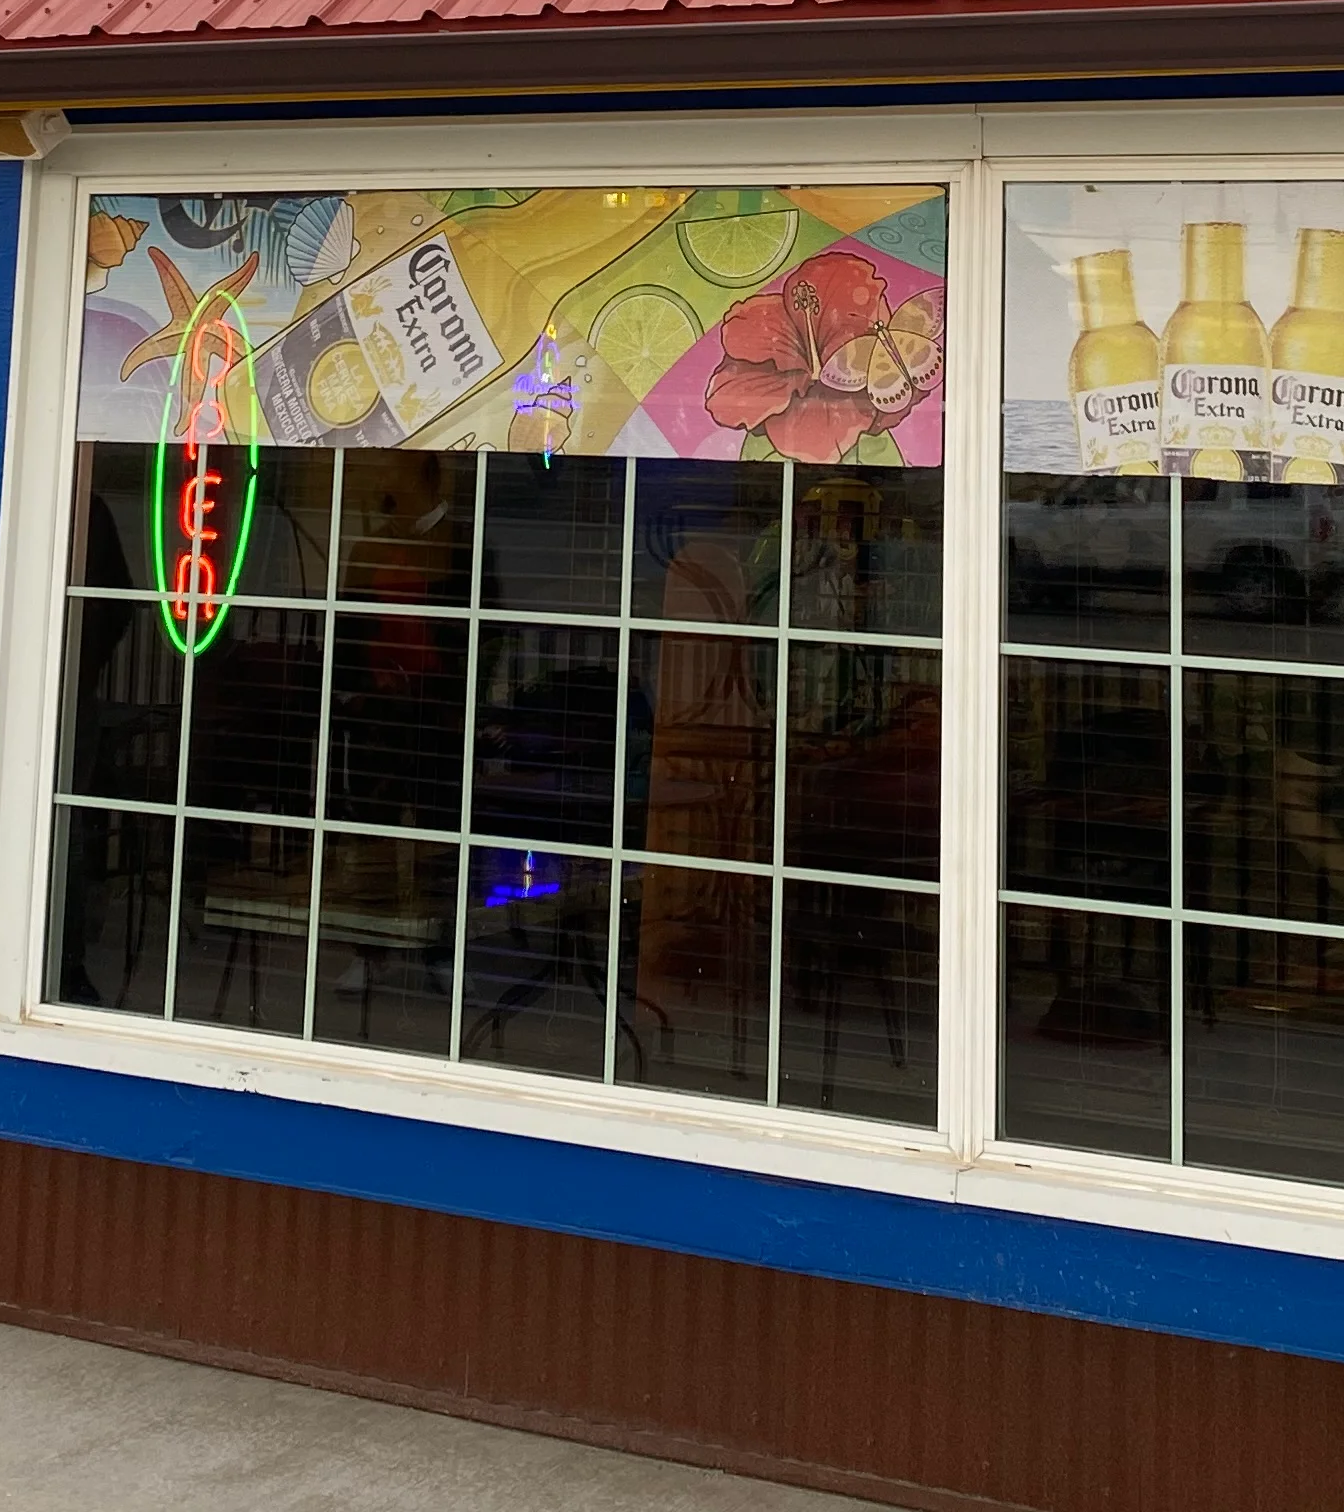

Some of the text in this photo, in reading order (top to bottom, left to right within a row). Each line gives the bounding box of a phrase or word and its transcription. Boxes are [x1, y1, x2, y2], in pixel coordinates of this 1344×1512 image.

[408, 243, 484, 380] Corona
[395, 294, 437, 374] Extra
[1170, 368, 1260, 405] Corona
[1107, 417, 1156, 436] Extra
[1194, 396, 1245, 420] Extra
[1291, 405, 1344, 433] Extra
[174, 319, 234, 620] OPEN
